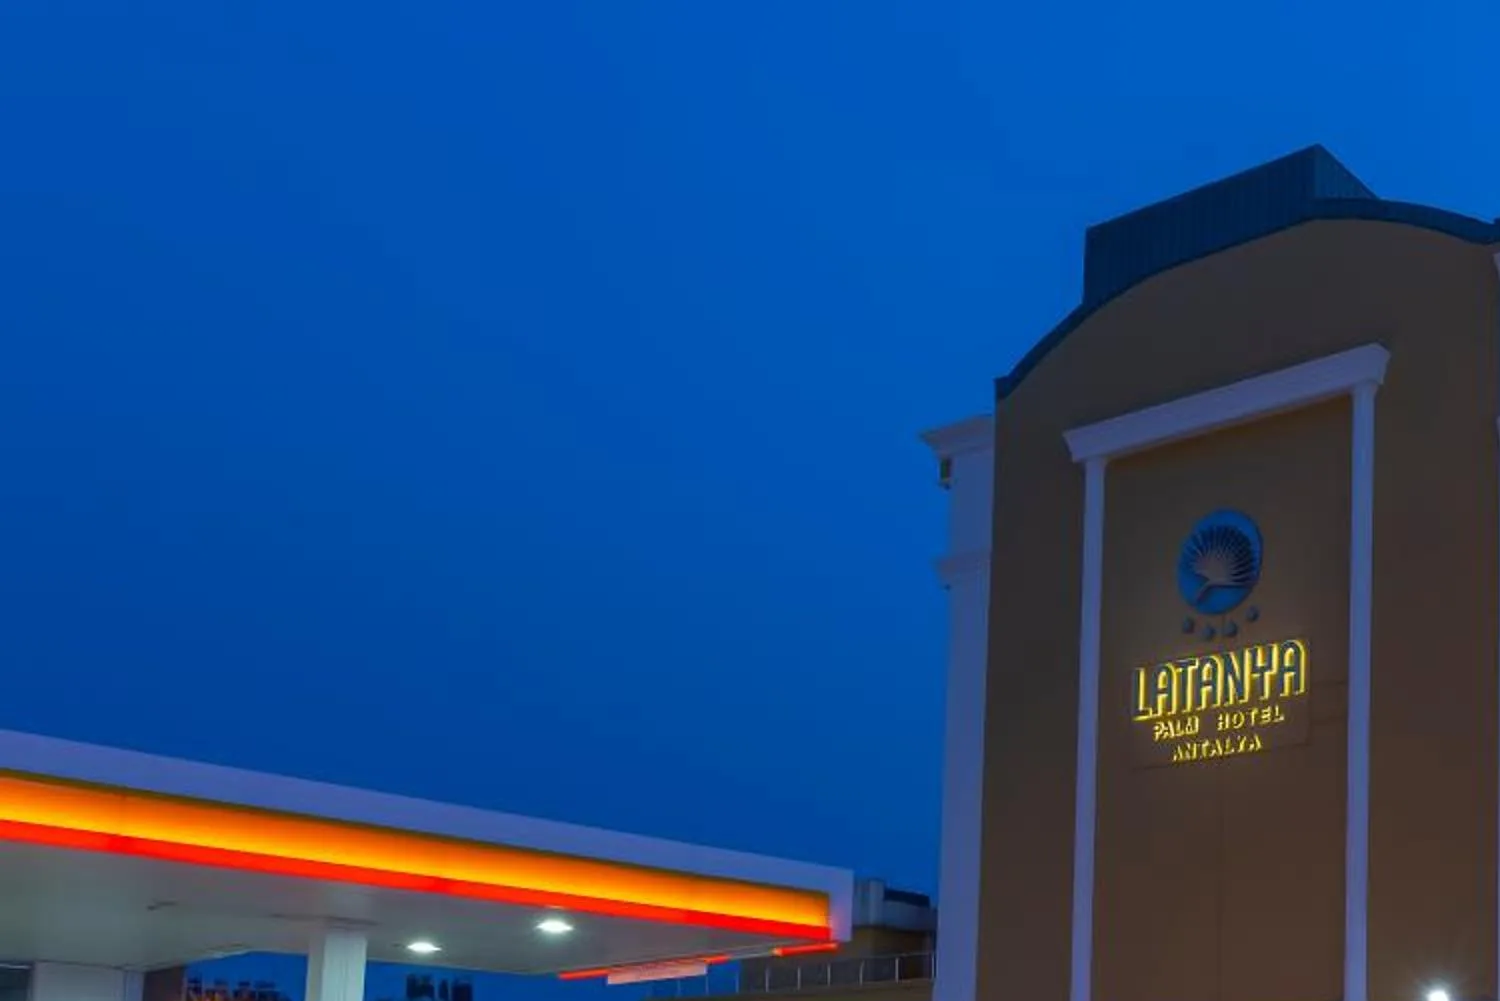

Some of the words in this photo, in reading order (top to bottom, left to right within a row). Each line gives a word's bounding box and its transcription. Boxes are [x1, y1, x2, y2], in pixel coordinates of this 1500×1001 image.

[1133, 639, 1308, 721] LATANYA
[1153, 717, 1200, 741] PALM
[1216, 705, 1284, 732] HOTEL
[1172, 735, 1262, 762] ANTALYA
